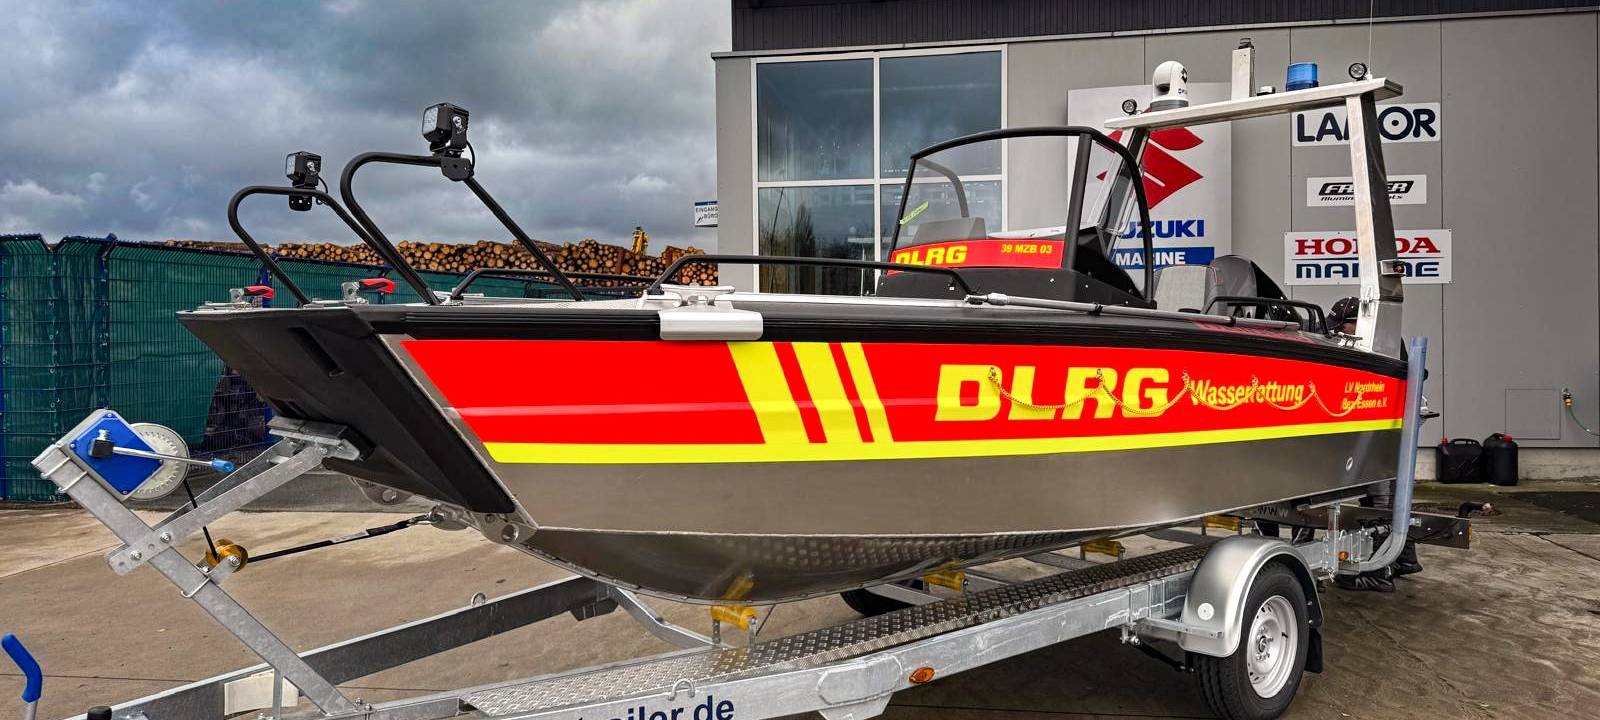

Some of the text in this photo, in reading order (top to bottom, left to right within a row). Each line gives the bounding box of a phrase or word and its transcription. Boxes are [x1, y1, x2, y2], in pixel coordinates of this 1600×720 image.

[1297, 106, 1436, 142] LAOR
[1001, 244, 1053, 254] 39 MZB 03
[1295, 236, 1441, 256] HODA
[1115, 251, 1186, 266] MAINE
[934, 364, 1170, 421] DLRG
